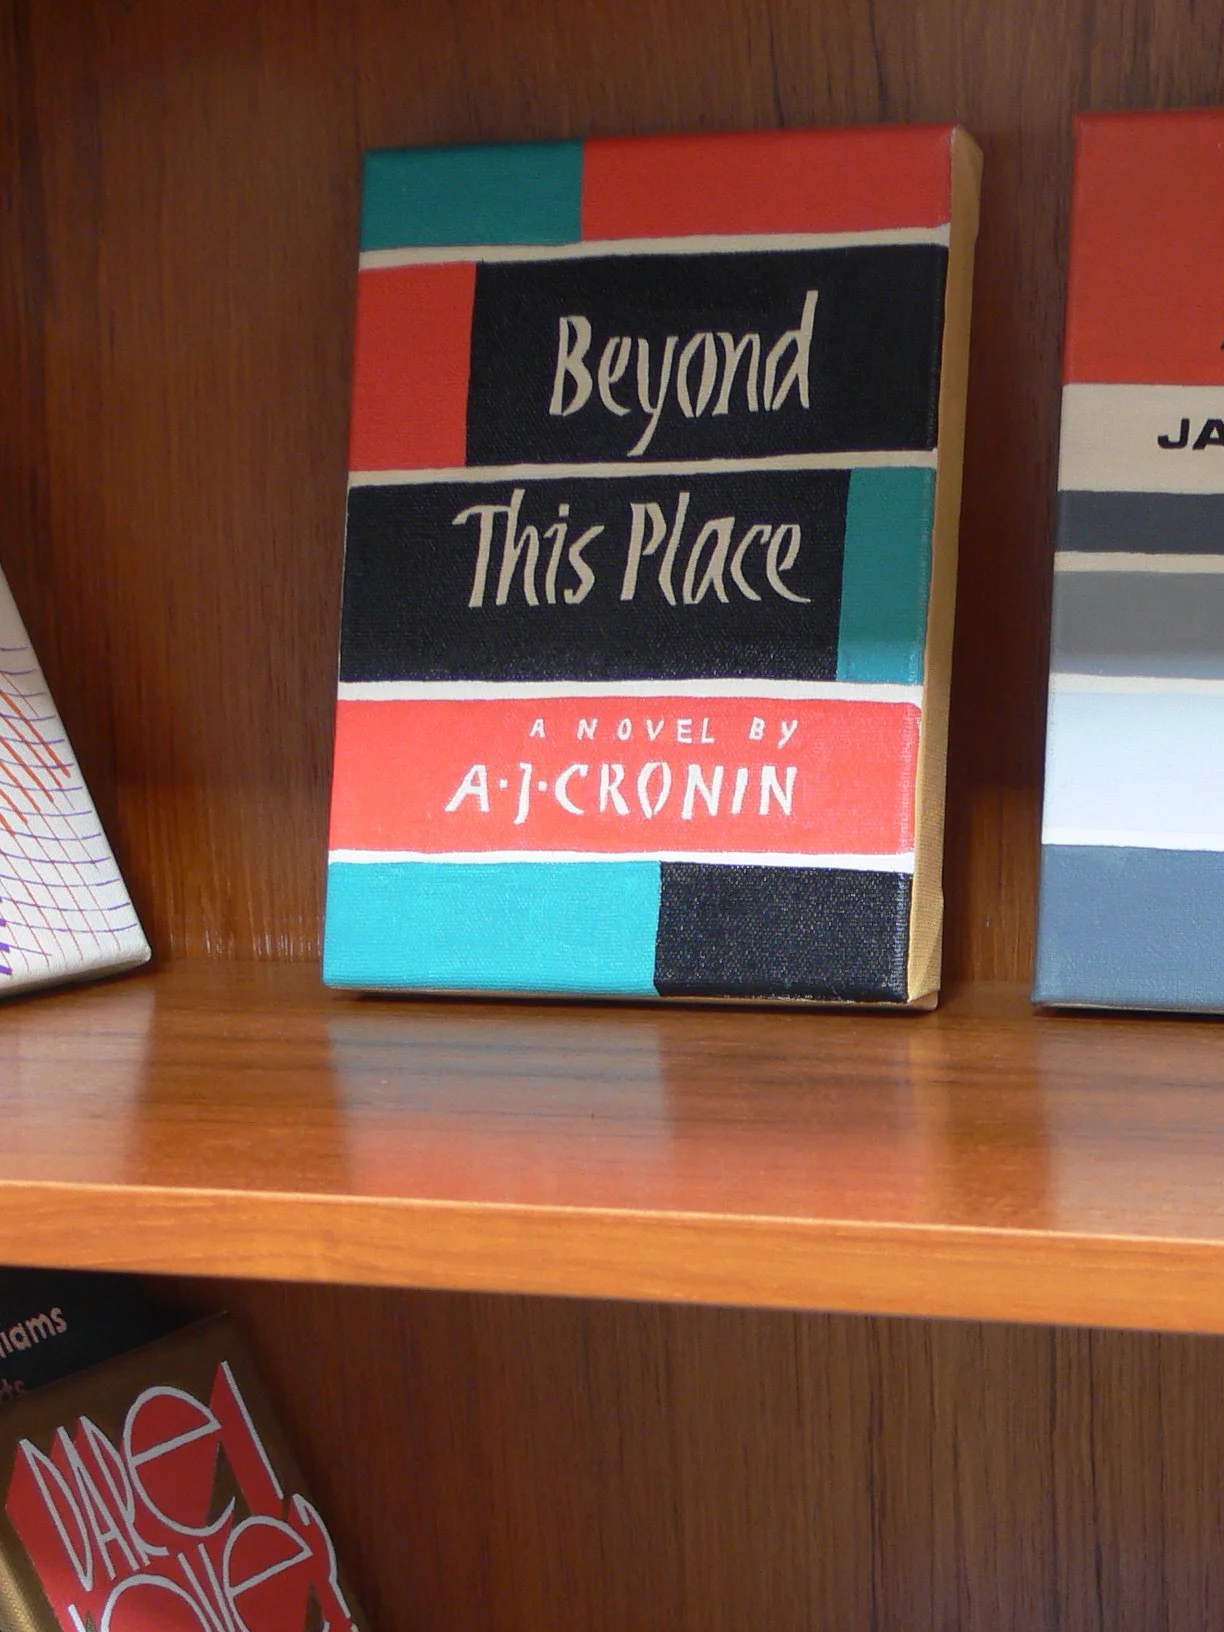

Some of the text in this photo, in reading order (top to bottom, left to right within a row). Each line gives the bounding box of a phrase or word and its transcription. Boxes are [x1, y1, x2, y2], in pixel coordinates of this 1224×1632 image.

[549, 290, 819, 457] Beyond
[453, 488, 812, 608] This Place
[530, 718, 546, 738] A
[577, 716, 716, 744] NOVEL
